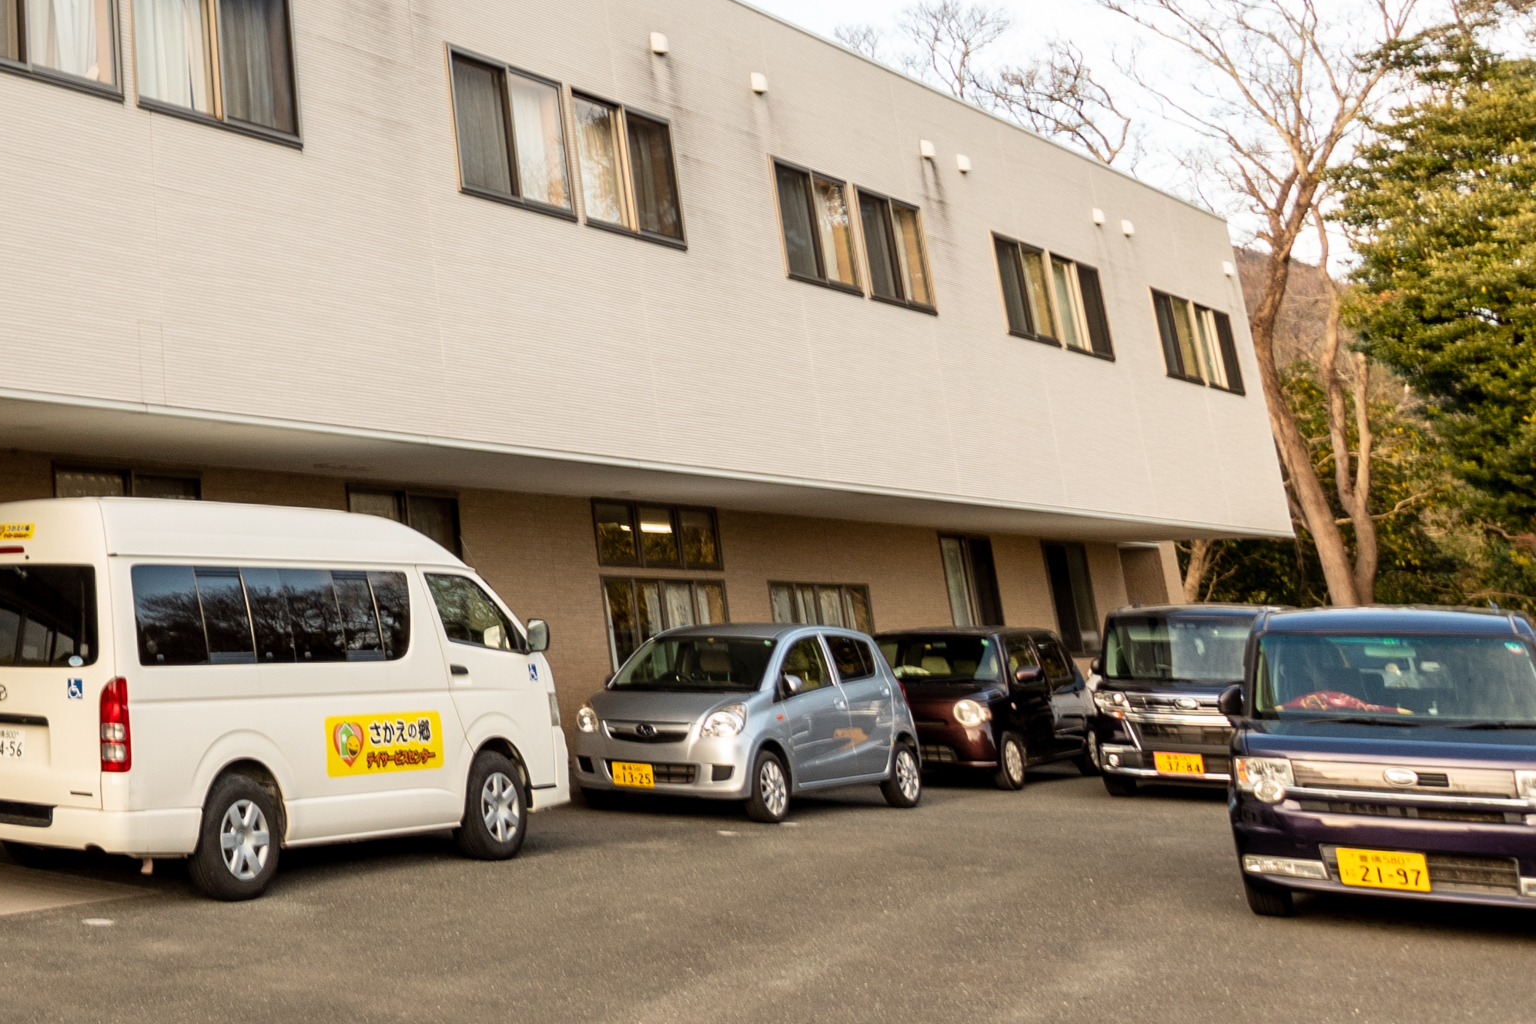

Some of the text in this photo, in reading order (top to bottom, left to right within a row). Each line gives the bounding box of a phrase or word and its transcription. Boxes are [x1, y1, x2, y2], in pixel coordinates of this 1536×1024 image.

[369, 718, 431, 744] さかえの郷
[366, 747, 436, 769] デイサービスセンター
[623, 772, 651, 784] 13-25
[1359, 865, 1421, 886] 21-97
